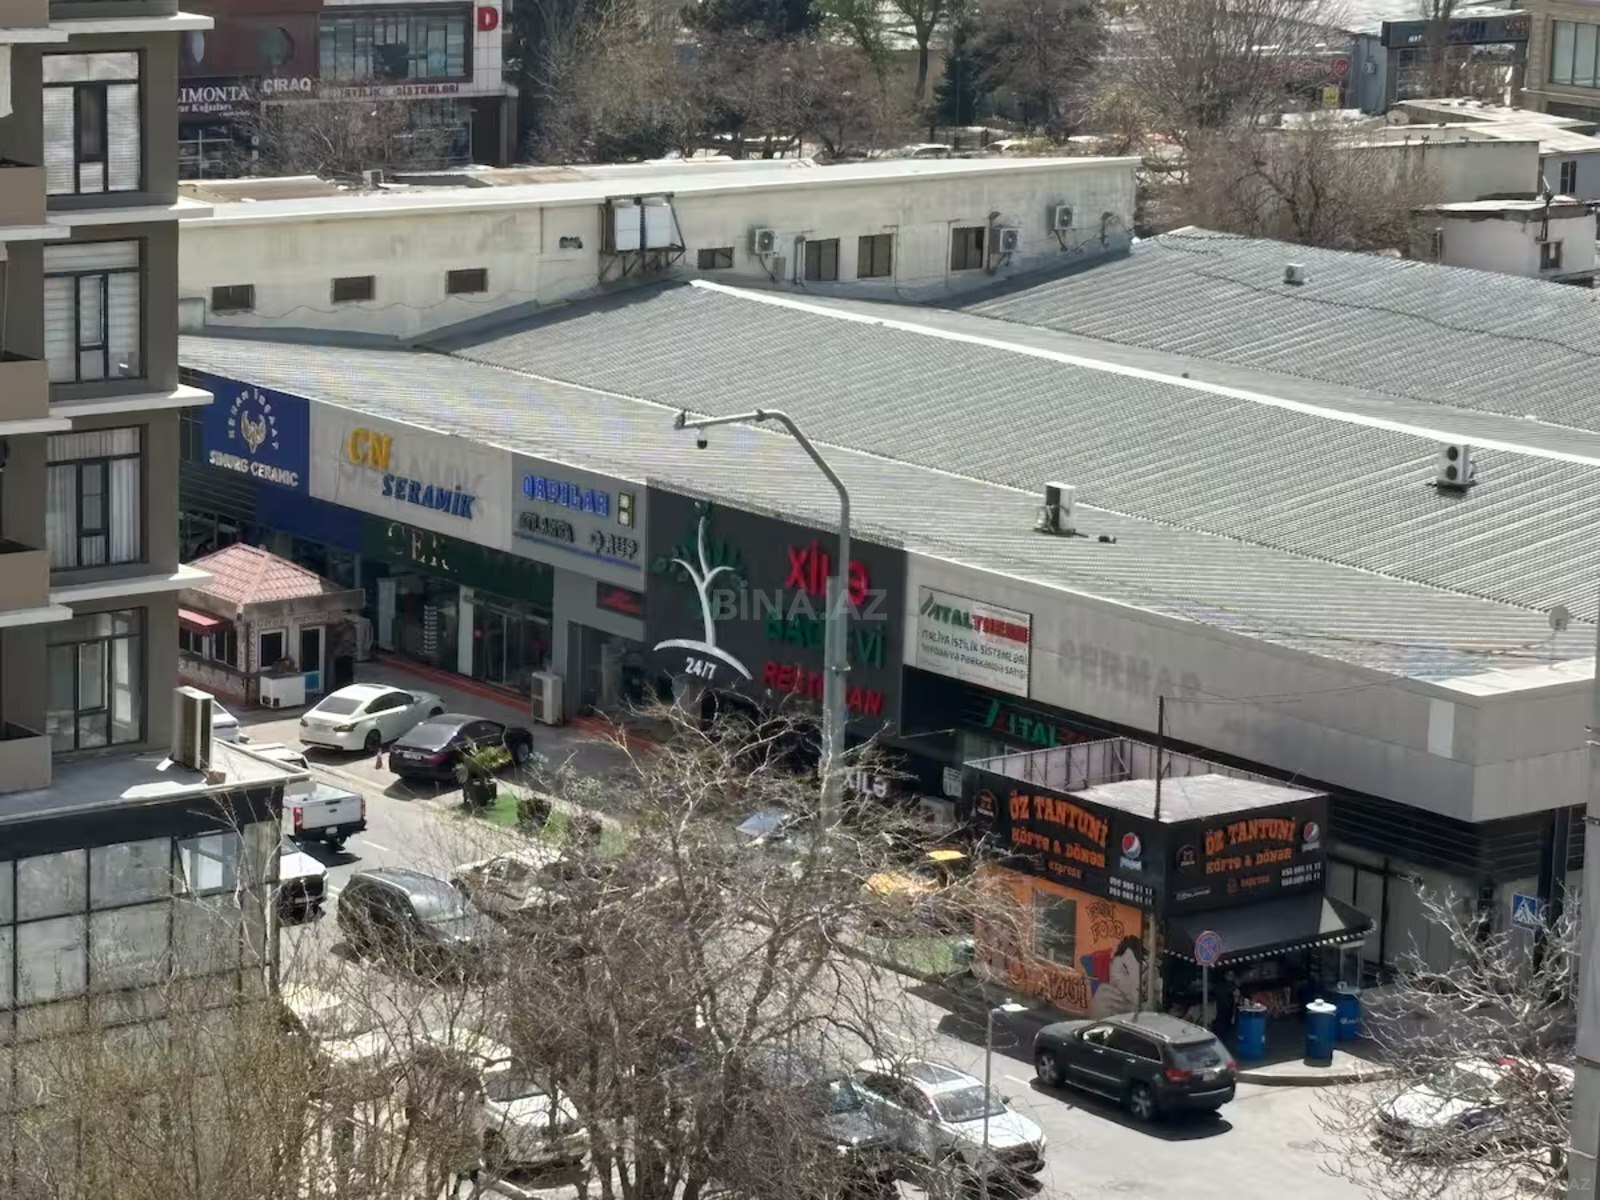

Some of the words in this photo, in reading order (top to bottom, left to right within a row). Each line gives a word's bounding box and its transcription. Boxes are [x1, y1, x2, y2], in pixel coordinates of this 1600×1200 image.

[477, 6, 500, 32] D
[178, 86, 251, 102] IMONTA
[347, 427, 394, 470] CN
[250, 461, 299, 487] CERAMIC
[684, 656, 718, 680] 24/7
[1009, 789, 1030, 821] ÖZ
[1034, 795, 1110, 848] TANTUNİ
[1053, 837, 1063, 855] &
